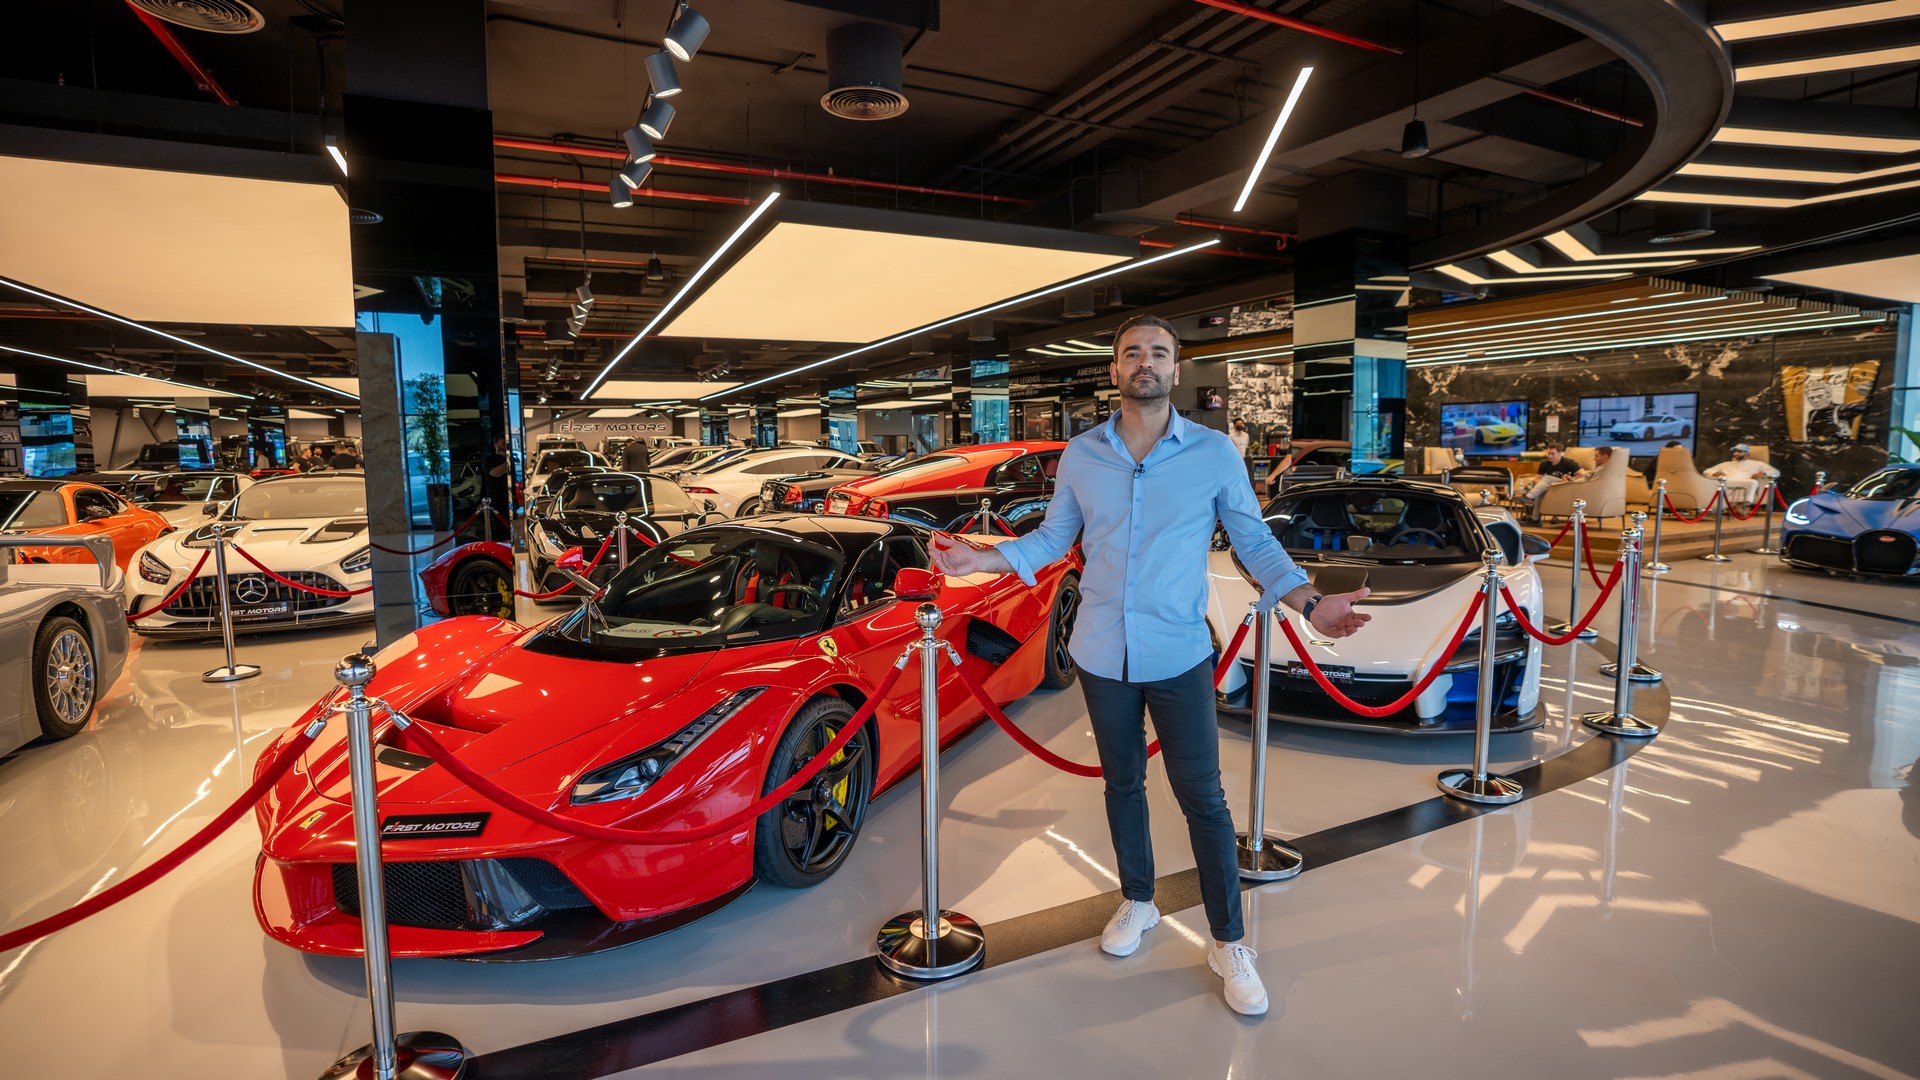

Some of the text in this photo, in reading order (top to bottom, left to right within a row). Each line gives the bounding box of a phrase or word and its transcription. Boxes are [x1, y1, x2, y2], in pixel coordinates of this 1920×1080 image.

[605, 422, 666, 432] MOTORS
[247, 606, 288, 615] MOTORS
[1321, 670, 1351, 678] OTORS
[424, 821, 482, 831] MOTORS
